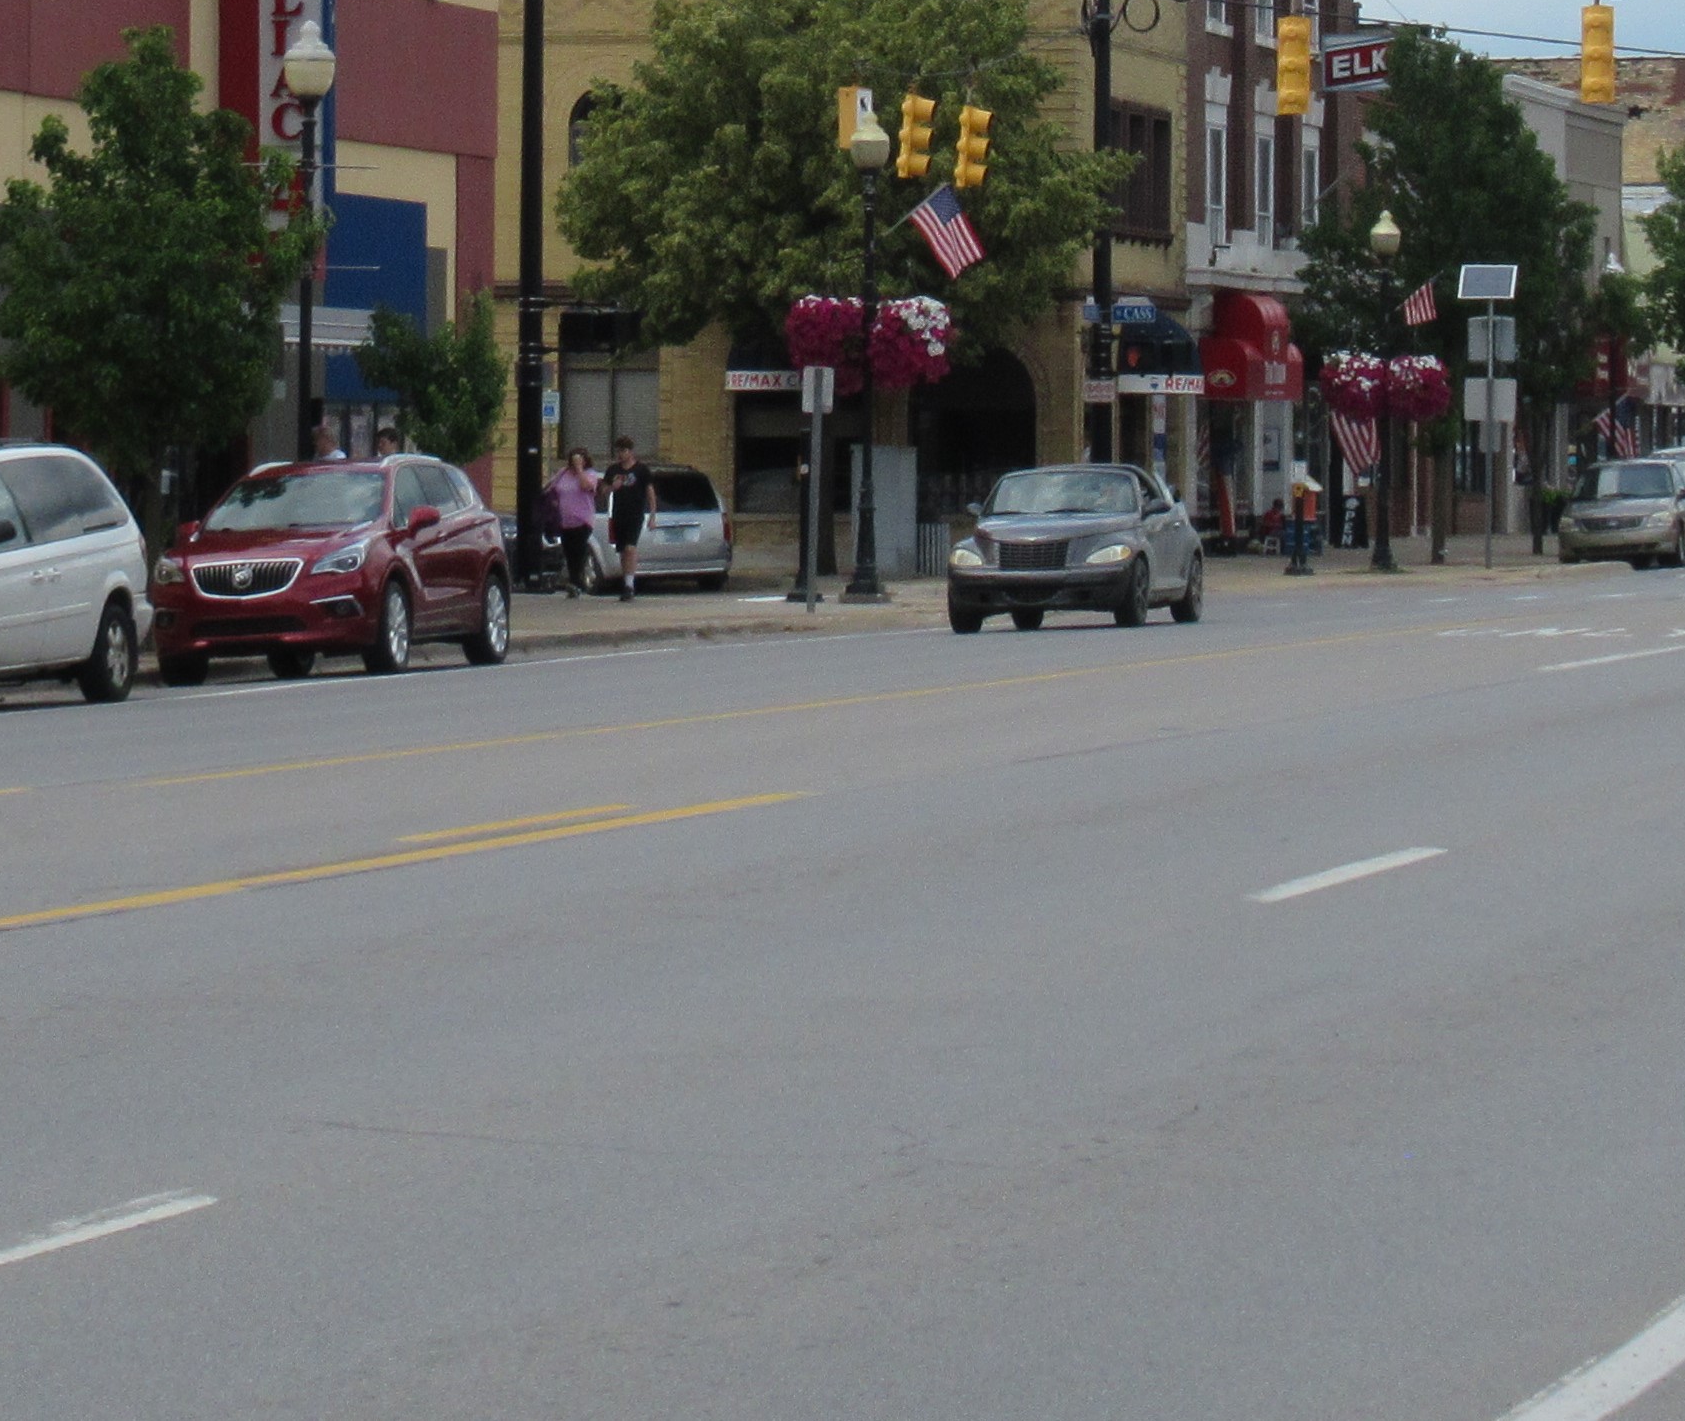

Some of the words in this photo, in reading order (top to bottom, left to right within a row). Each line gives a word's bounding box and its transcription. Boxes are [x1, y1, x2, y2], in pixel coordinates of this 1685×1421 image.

[1123, 307, 1153, 320] CASS
[731, 374, 782, 388] RE/MAX
[1165, 378, 1204, 390] RE/MA
